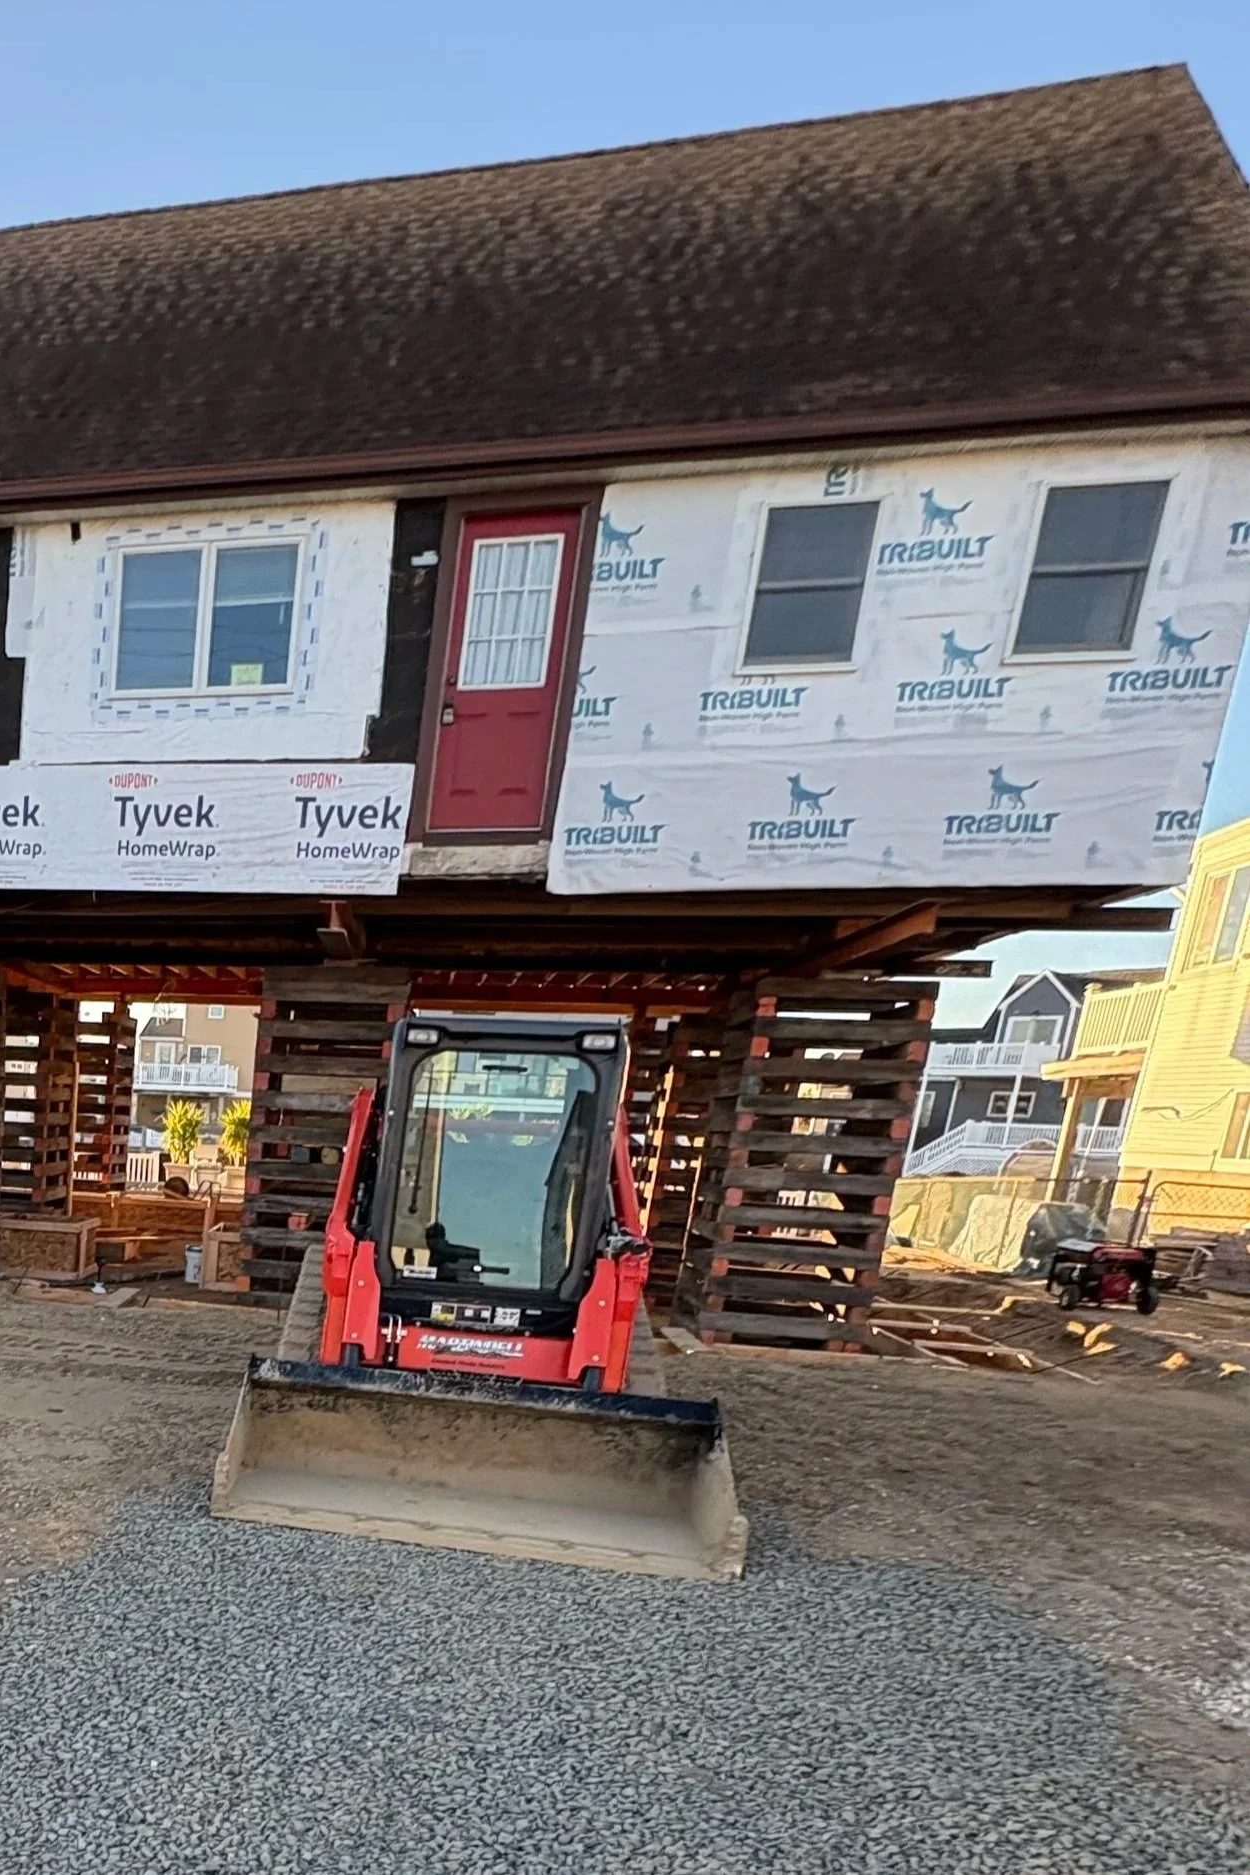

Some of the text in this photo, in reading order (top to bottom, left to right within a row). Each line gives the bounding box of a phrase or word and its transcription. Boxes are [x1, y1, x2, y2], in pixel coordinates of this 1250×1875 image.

[877, 535, 993, 565] TRIBUILT
[896, 677, 1012, 702] TRIBUILT
[1106, 664, 1232, 692] TRIBUILT
[700, 686, 806, 711] TRIBUILT
[114, 773, 153, 789] DUPONT
[295, 772, 337, 789] DUPONT
[114, 795, 215, 837] Tyvek
[295, 796, 402, 838] Tyvek
[944, 812, 1059, 835] TRIBUILT
[564, 824, 664, 846] TRIBUILT
[747, 817, 854, 841] TRIBUILT
[117, 840, 216, 860] HomeWrap
[296, 842, 400, 862] HomeWrap
